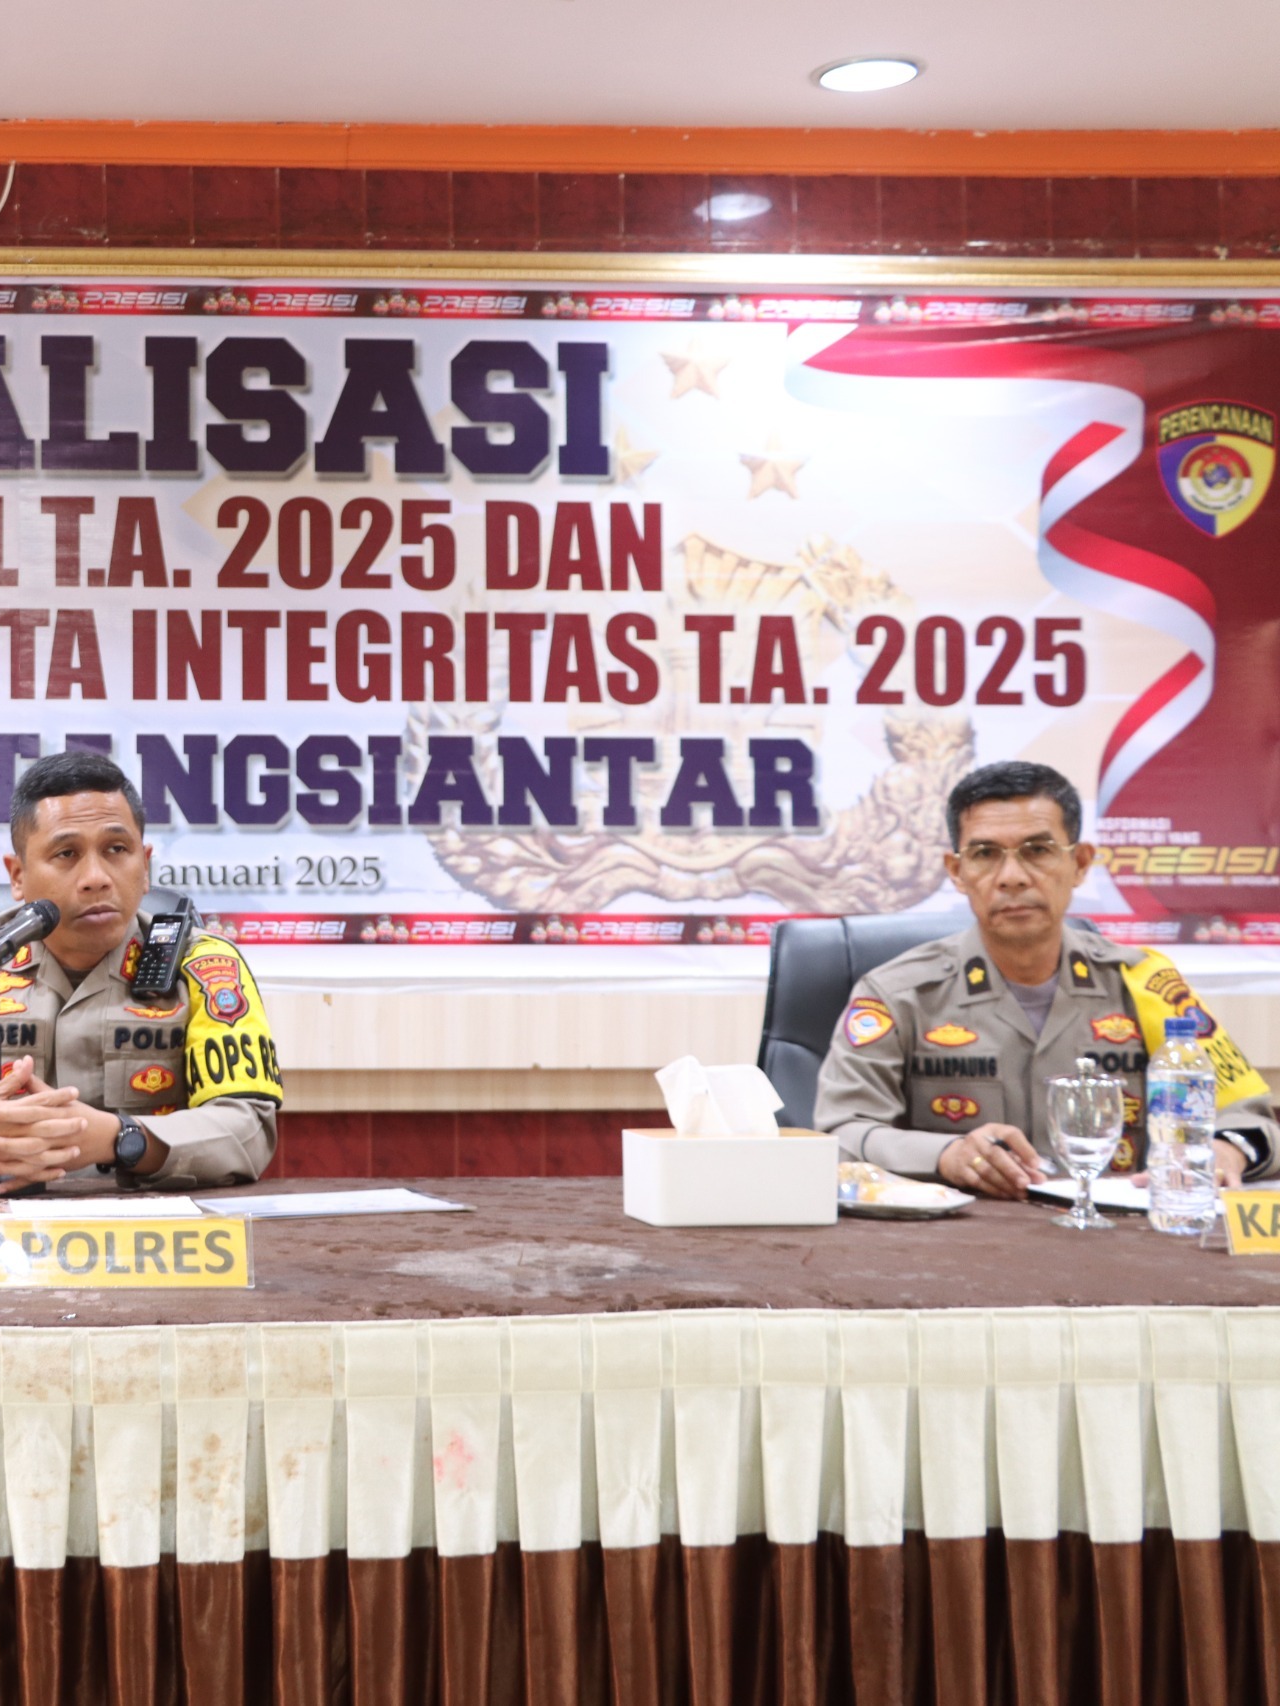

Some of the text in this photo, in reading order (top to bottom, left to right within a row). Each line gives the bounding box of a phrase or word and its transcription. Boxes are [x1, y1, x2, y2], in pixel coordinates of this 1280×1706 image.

[83, 291, 188, 305] PRESISI
[253, 293, 358, 307] PRESISI
[423, 295, 527, 309] PRESISI
[591, 298, 695, 312] PRESISI
[923, 302, 1027, 316] PRESISI
[1090, 304, 1194, 318] PRESISI
[1160, 404, 1274, 444] PERENCANAAN
[40, 496, 192, 588] T.A.
[216, 495, 457, 591] 2025
[485, 500, 663, 592] DAN
[132, 608, 660, 706] INTEGRITAS
[684, 614, 828, 705] T.A.
[855, 615, 1086, 708] 2025
[296, 856, 382, 886] 2025
[240, 921, 346, 935] PRESISI
[411, 921, 517, 935] PRESISI
[580, 922, 685, 936] PRESISI
[114, 1026, 186, 1051] POLR
[204, 1033, 258, 1085] OPS
